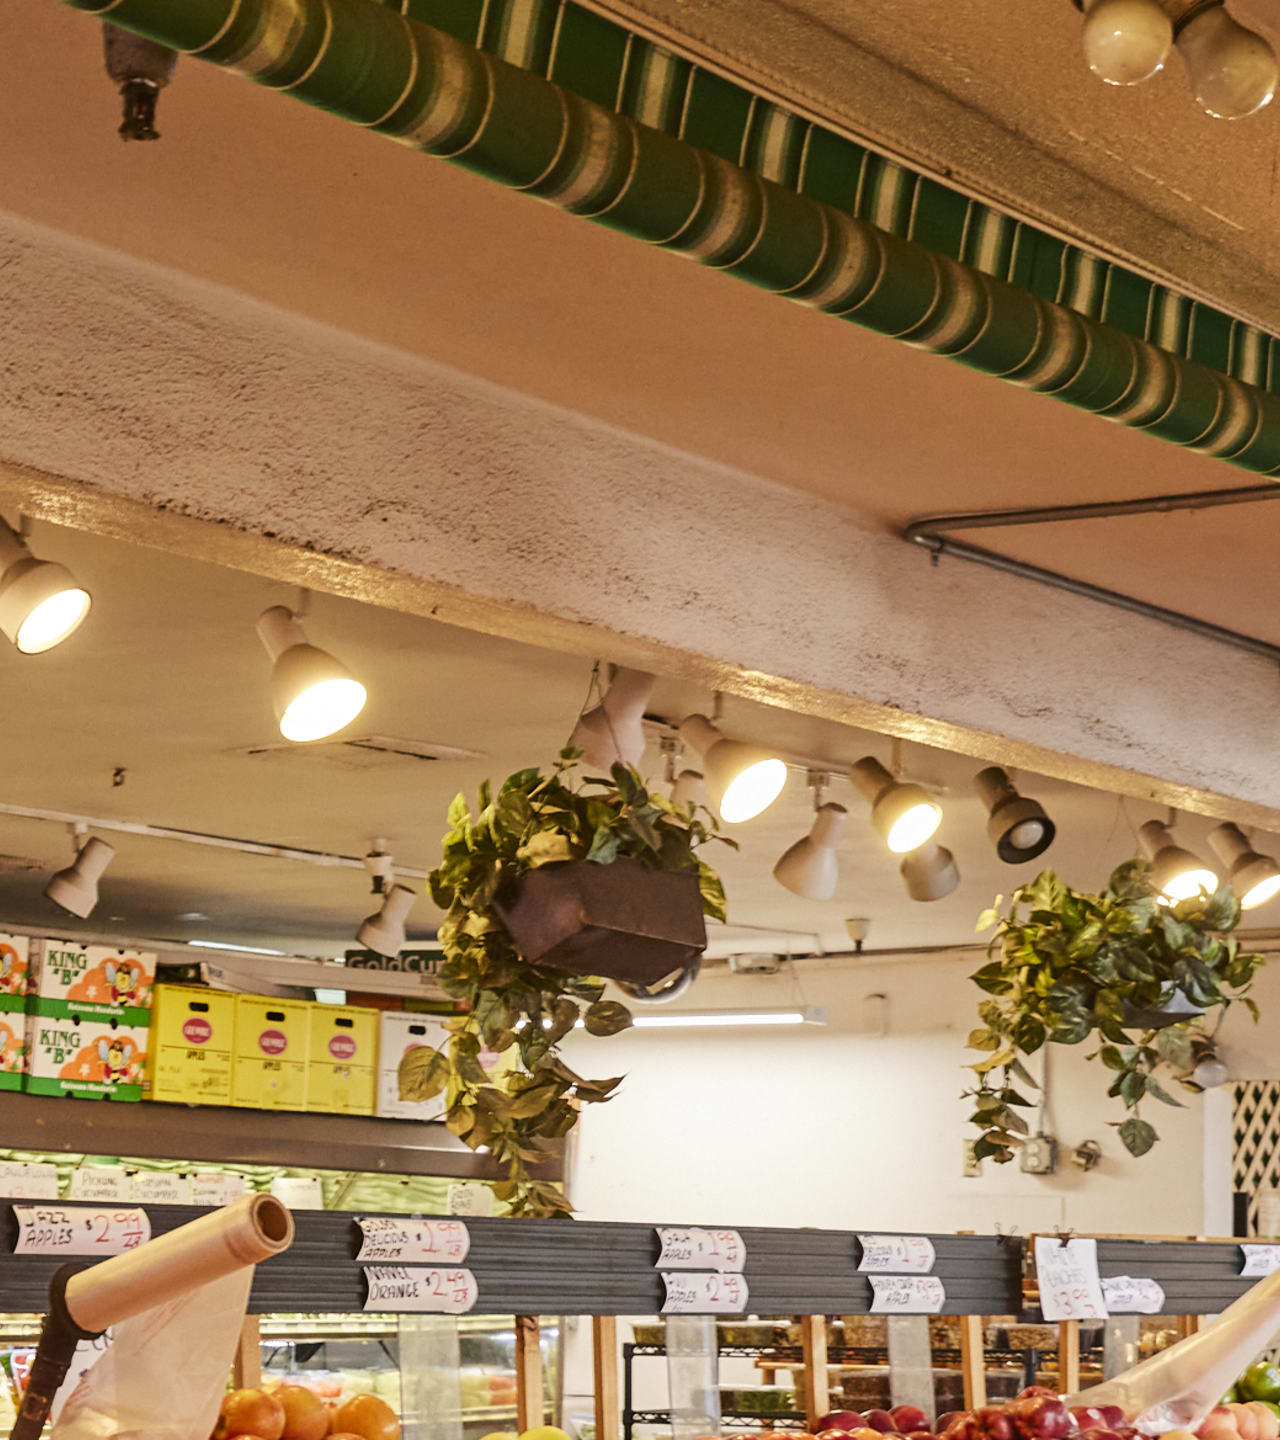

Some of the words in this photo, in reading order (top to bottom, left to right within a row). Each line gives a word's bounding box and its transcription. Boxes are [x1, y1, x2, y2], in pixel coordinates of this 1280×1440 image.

[48, 951, 87, 969] KING
[40, 1029, 81, 1048] KING
[46, 1047, 73, 1064] "B"
[24, 1229, 73, 1247] APPLES
[369, 1281, 419, 1301] ORANGE
